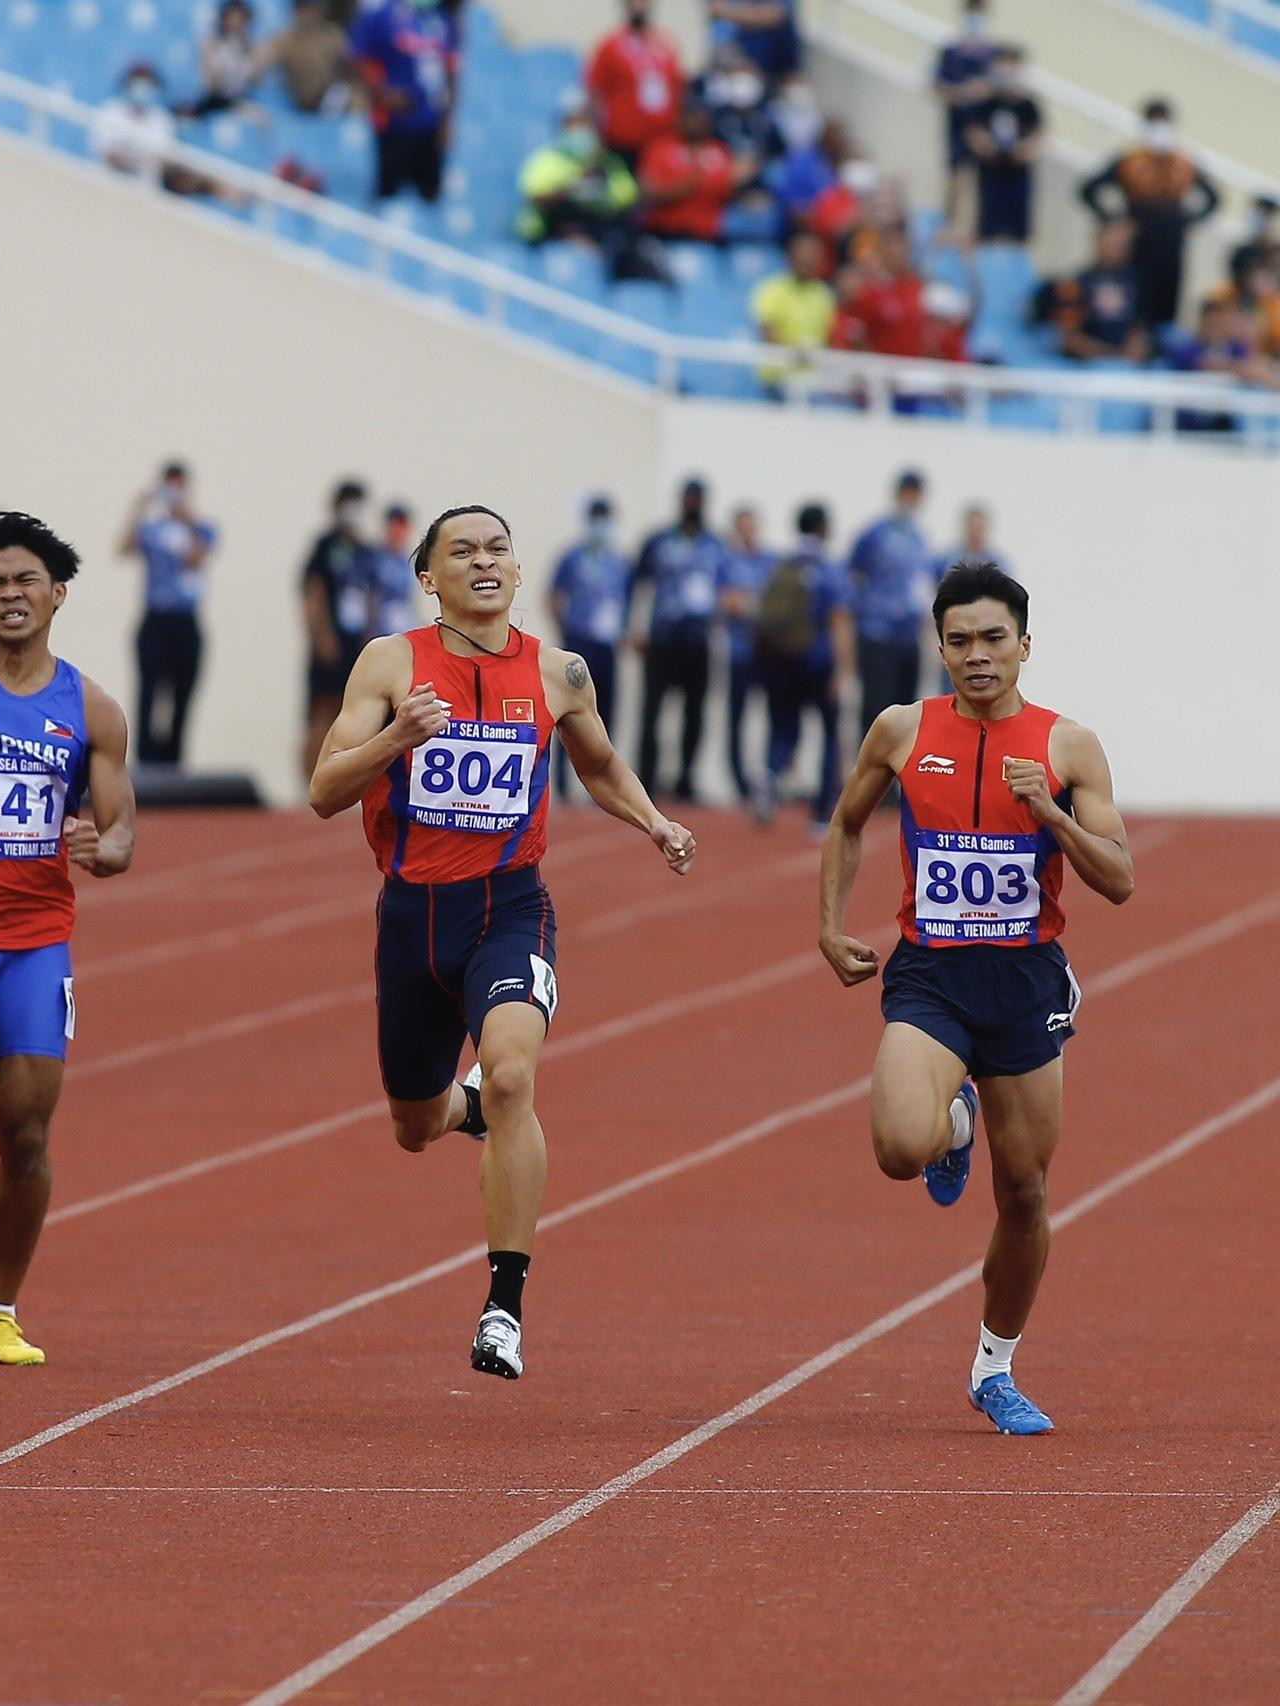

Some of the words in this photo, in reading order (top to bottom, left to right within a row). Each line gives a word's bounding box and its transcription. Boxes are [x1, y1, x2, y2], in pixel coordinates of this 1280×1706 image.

[459, 722, 480, 738] SEA
[482, 724, 518, 740] Games
[420, 748, 524, 798] 804
[452, 802, 490, 810] VIETNAM
[416, 810, 446, 826] HANOI
[454, 813, 496, 830] VIETNAM
[3, 842, 39, 857] VIETNAM
[958, 835, 978, 850] SEA
[980, 837, 1015, 851] Games
[926, 860, 1029, 906] 803
[959, 911, 999, 919] VIETNAM
[925, 922, 955, 937] HANOI
[963, 922, 1007, 937] VIETNAM
